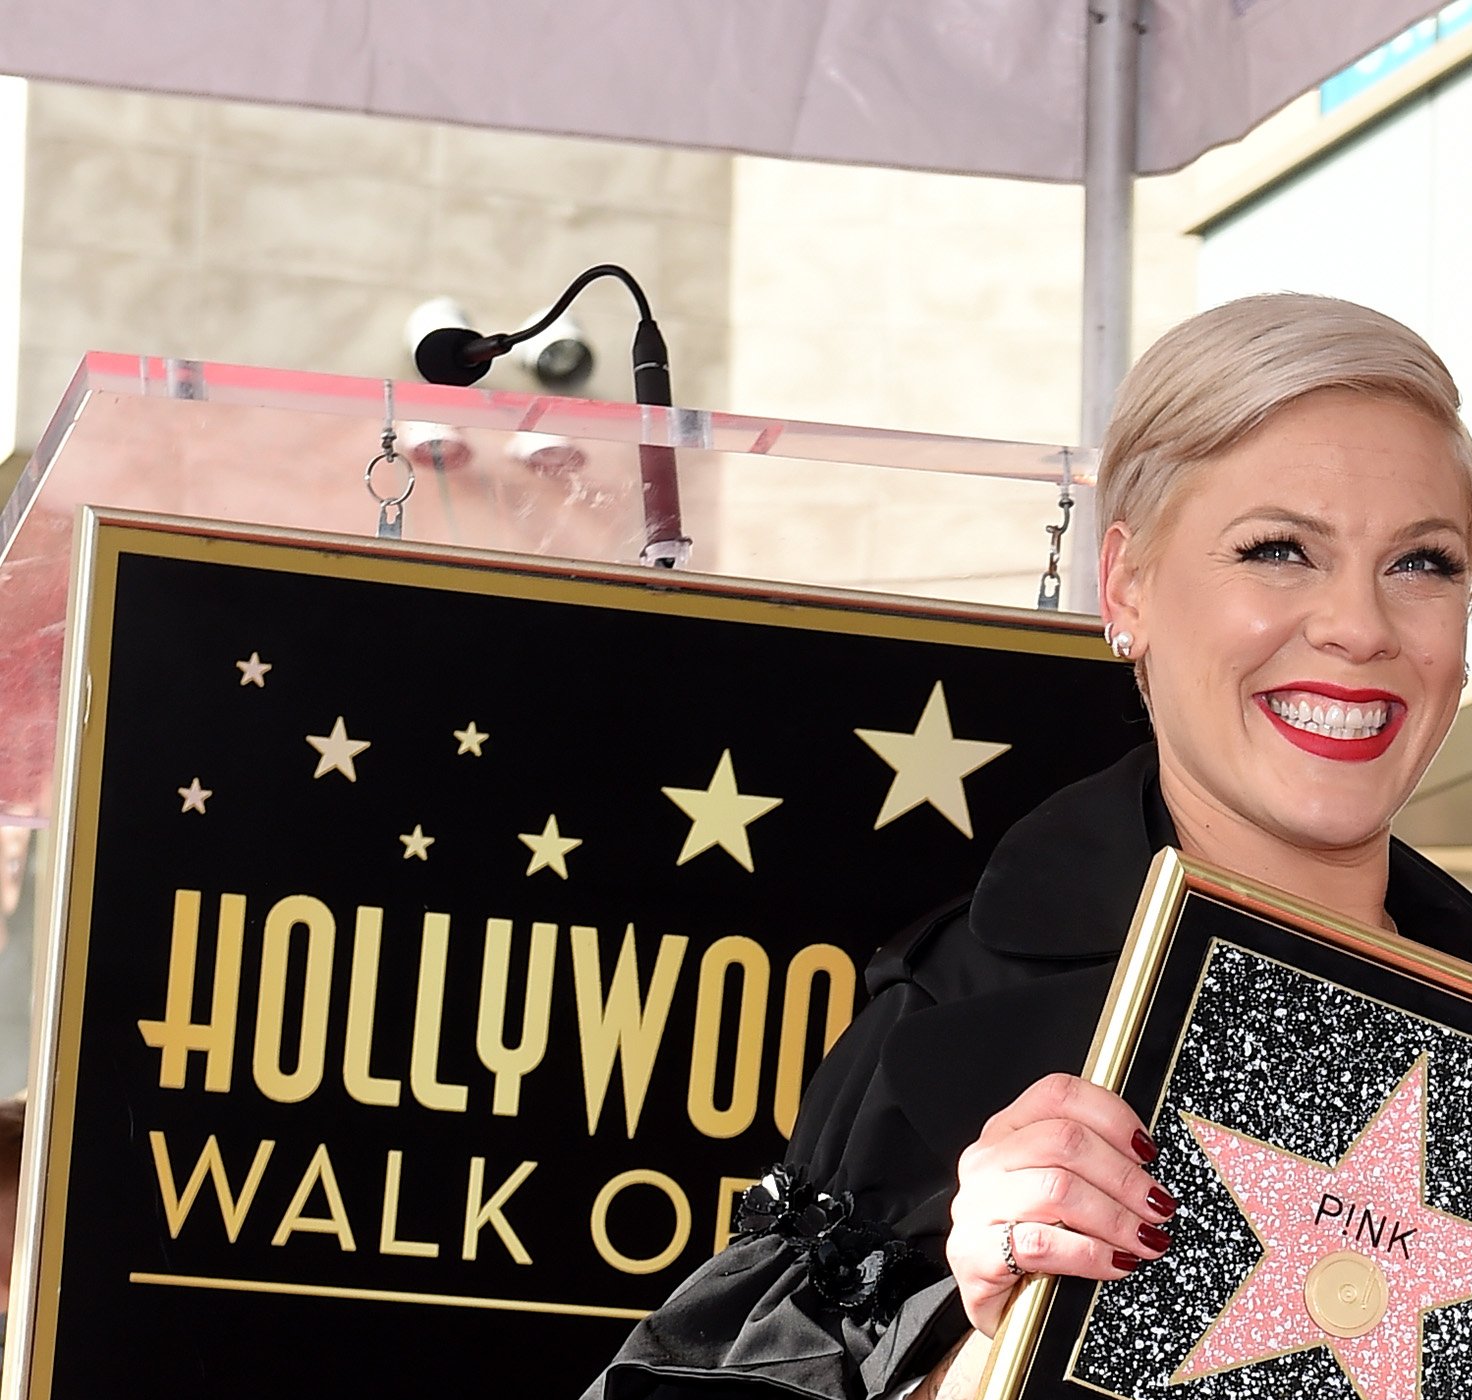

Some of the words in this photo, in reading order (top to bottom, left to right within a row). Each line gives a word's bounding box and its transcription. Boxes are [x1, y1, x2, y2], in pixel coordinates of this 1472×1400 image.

[150, 1131, 538, 1266] WALK
[590, 1168, 765, 1275] OF
[1314, 1193, 1418, 1260] P!NK
